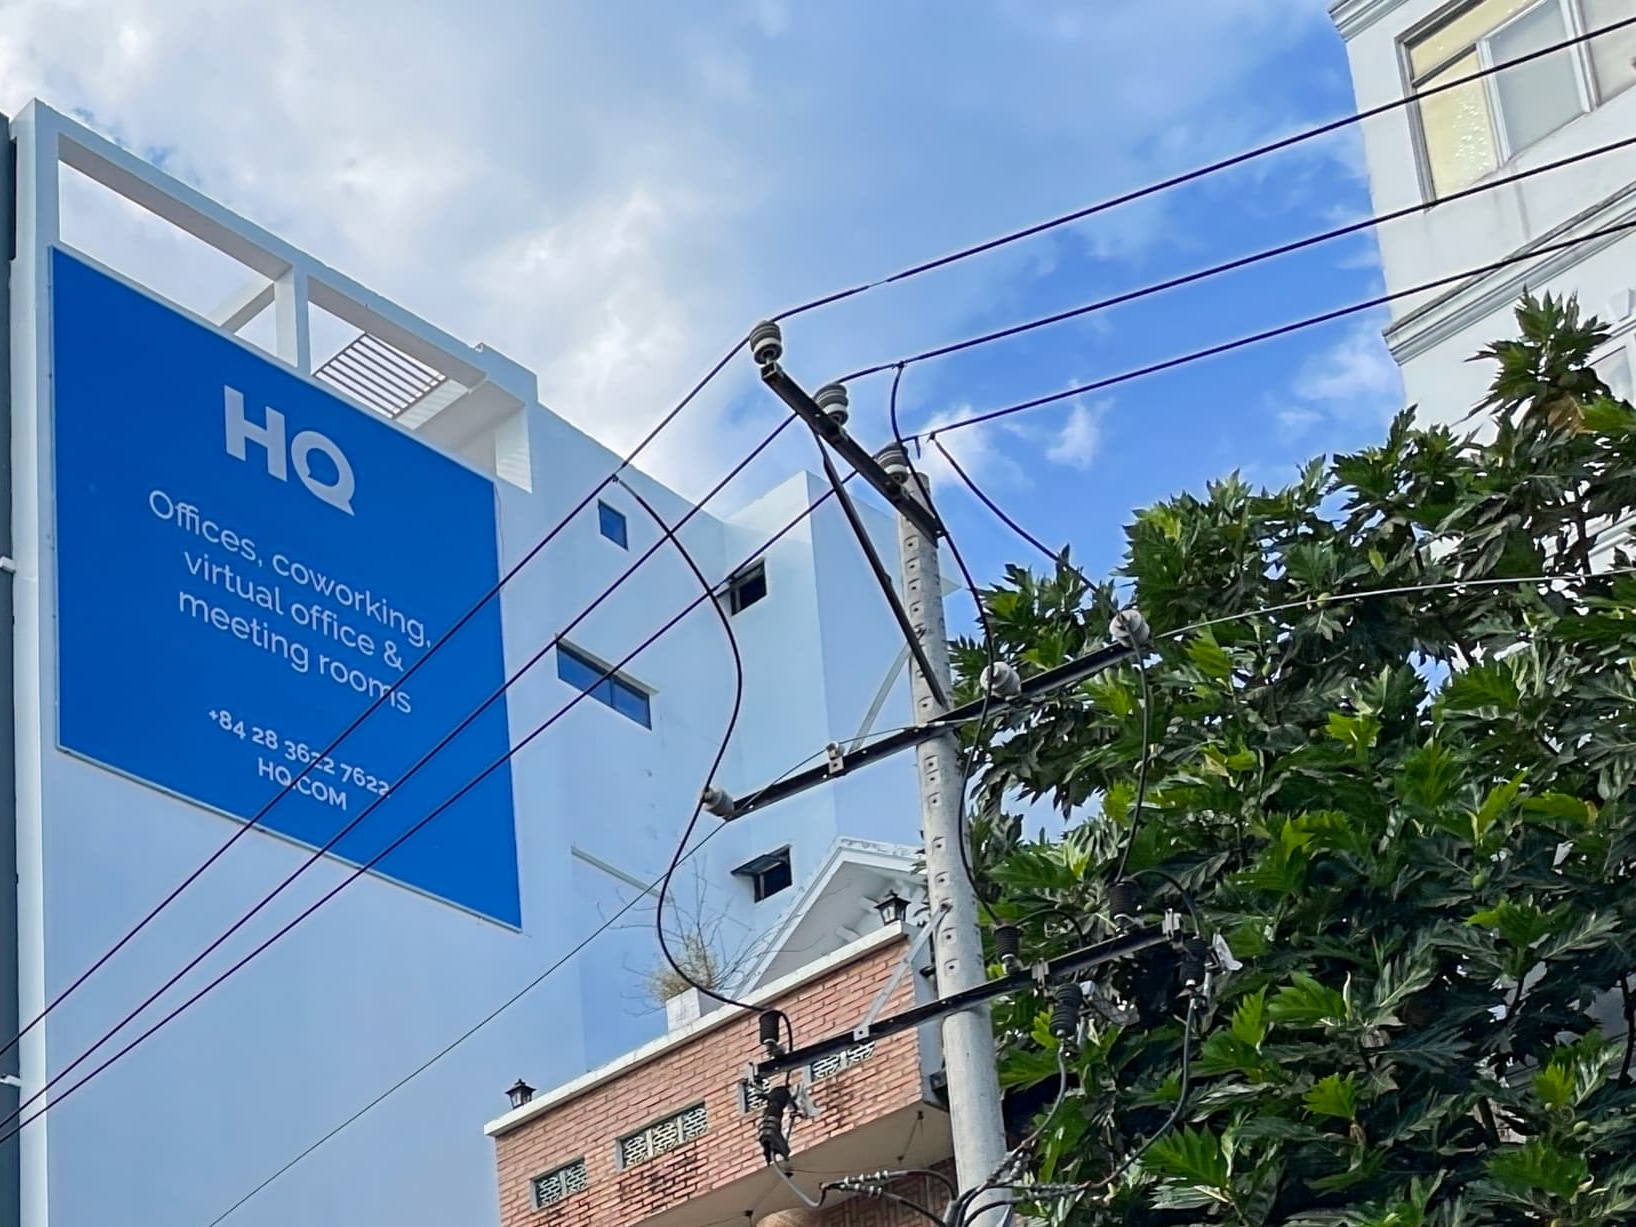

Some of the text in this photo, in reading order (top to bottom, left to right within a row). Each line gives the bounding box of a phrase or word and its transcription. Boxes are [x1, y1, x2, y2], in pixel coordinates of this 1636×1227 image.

[224, 384, 356, 516] HQ
[149, 490, 431, 649] Offices, coworking,
[184, 551, 405, 672] virtual office &
[179, 590, 412, 713] meeting rooms
[209, 709, 392, 798] +84 28 3622 7622
[257, 756, 348, 811] HQ.COM
